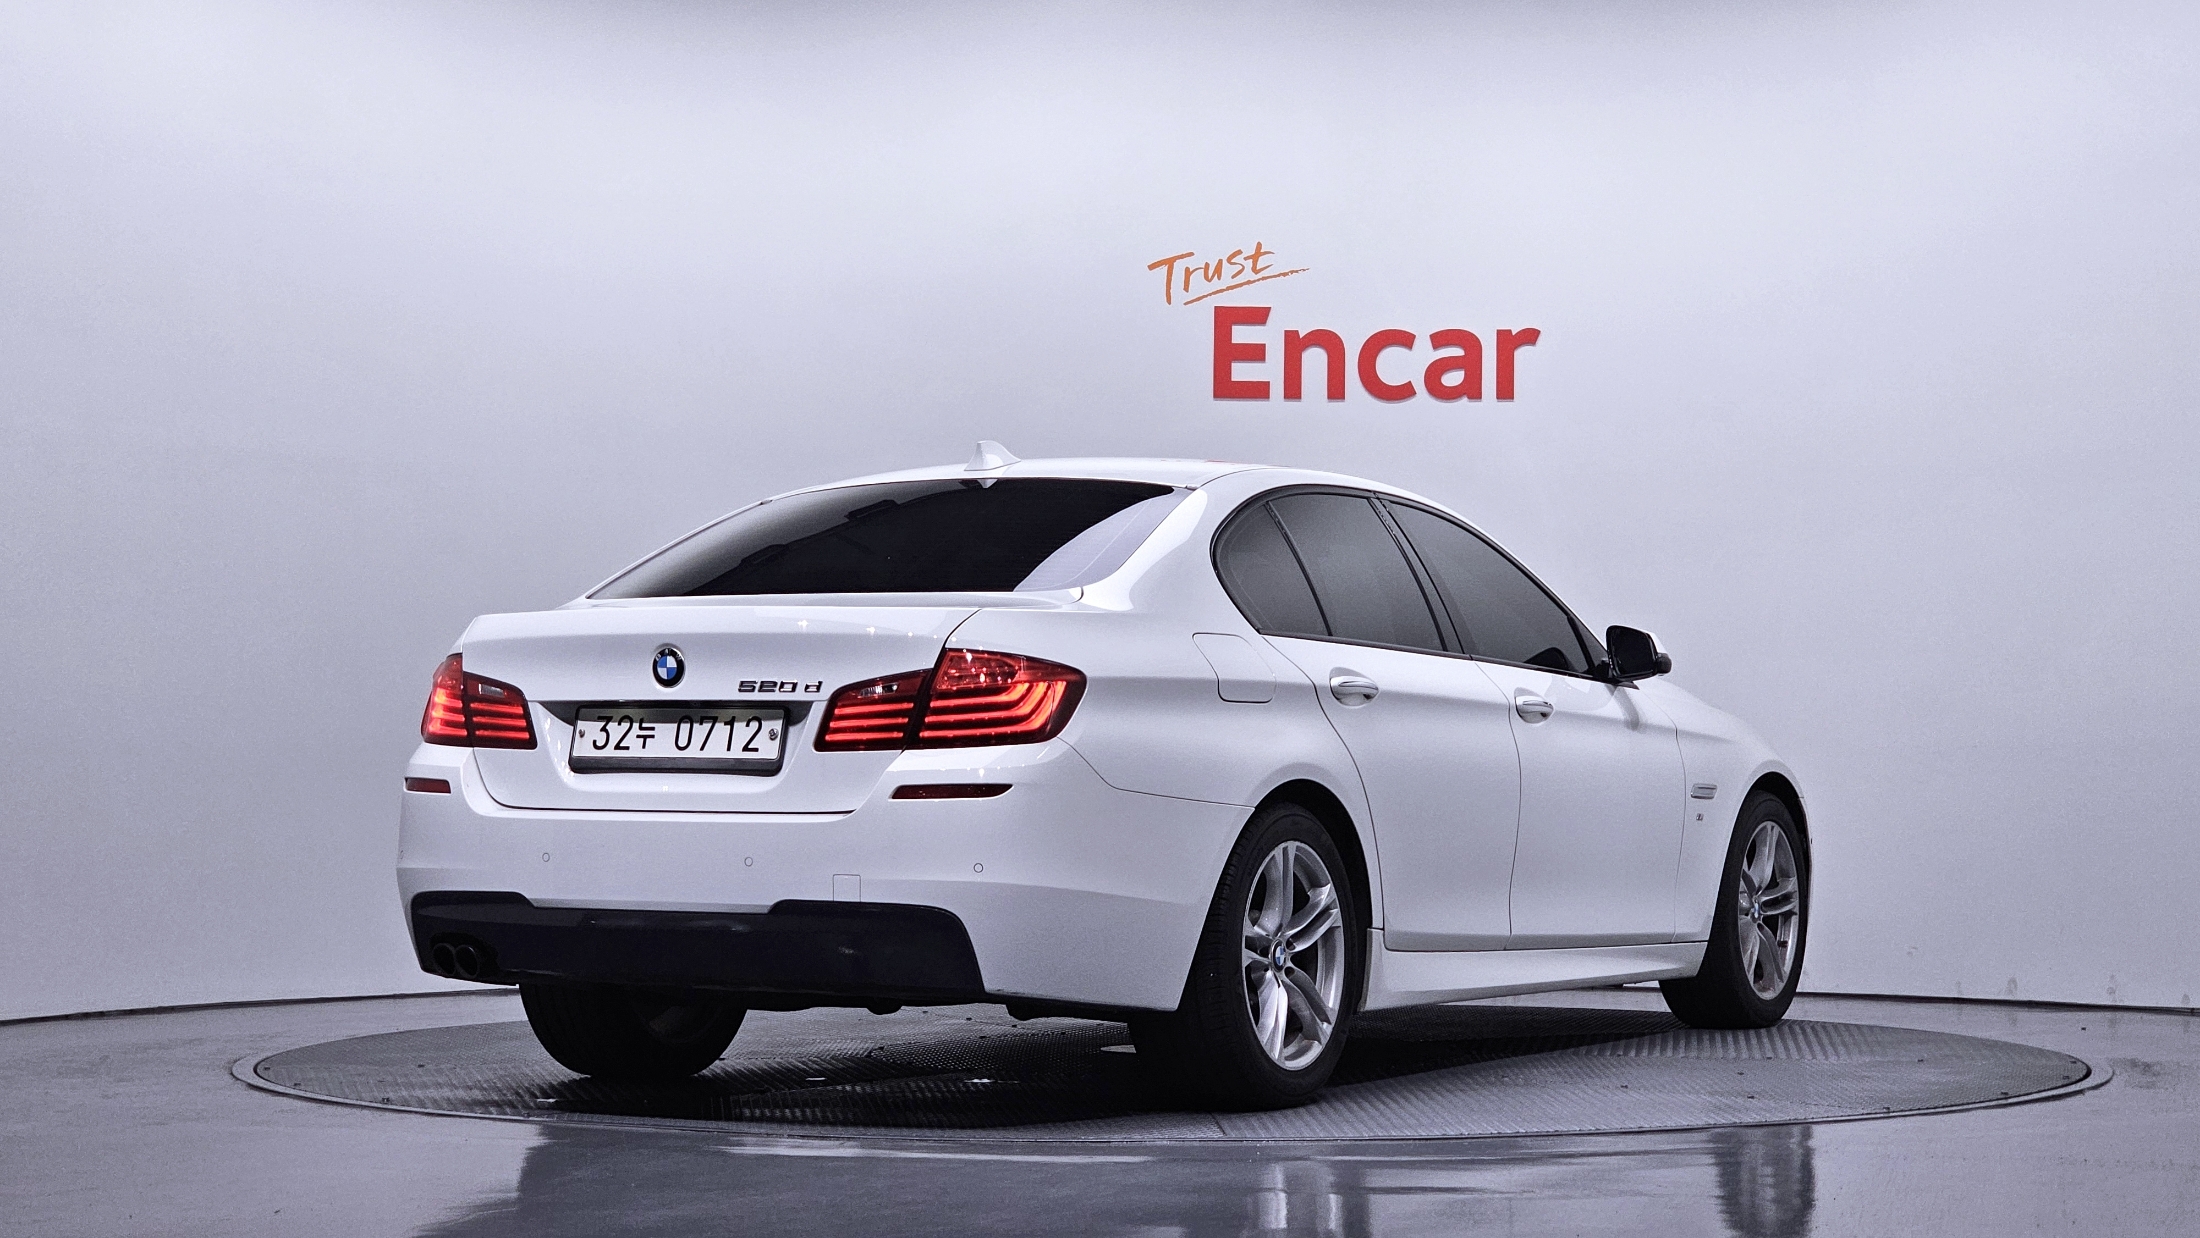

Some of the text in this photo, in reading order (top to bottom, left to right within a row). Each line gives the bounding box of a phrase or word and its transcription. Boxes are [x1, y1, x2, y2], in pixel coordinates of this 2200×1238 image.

[1147, 241, 1276, 305] Trust
[1213, 305, 1541, 402] Encar
[592, 715, 763, 752] 32누 0712
